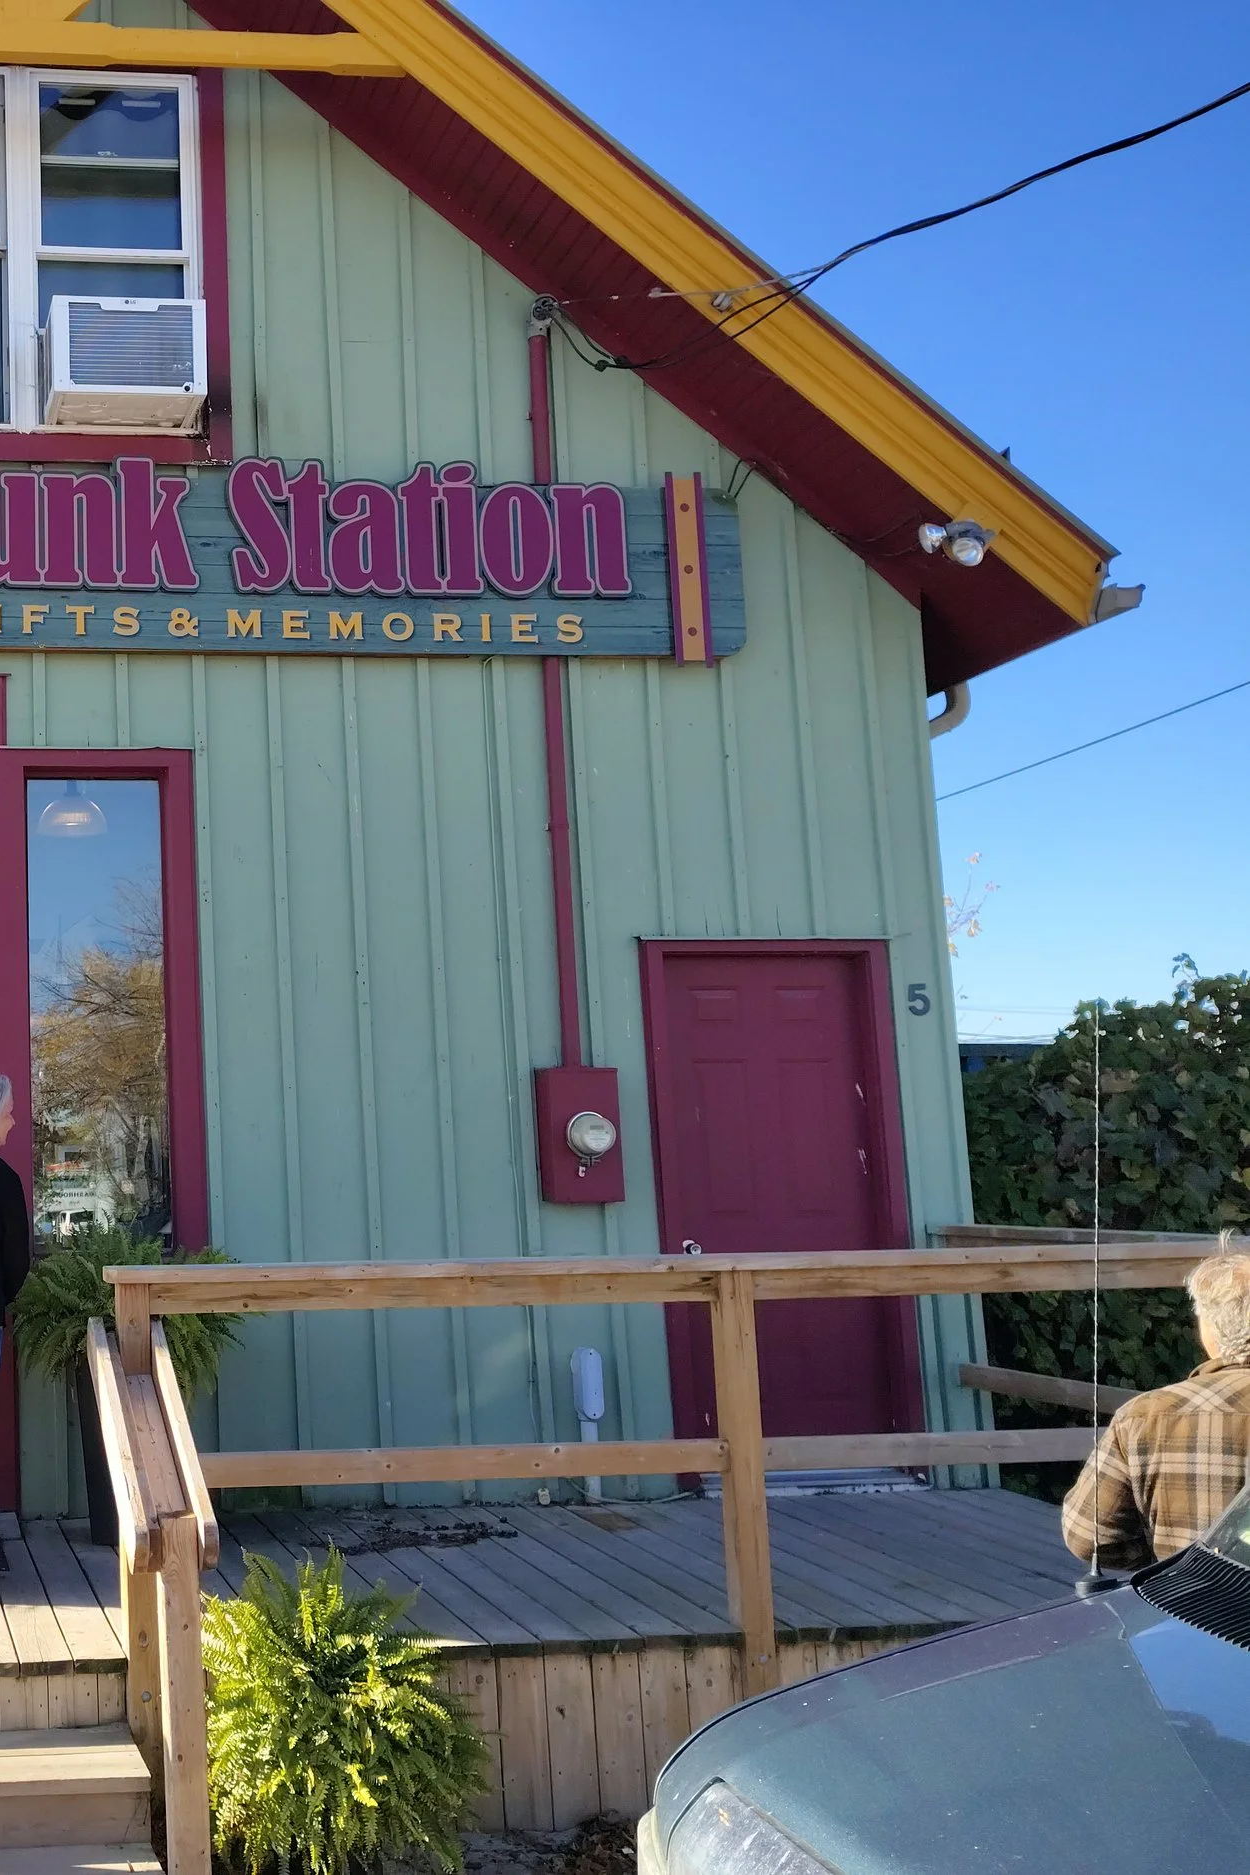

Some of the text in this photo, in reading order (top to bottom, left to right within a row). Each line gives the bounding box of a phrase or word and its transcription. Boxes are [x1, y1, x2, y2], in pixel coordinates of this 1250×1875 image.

[227, 456, 633, 598] Station
[167, 607, 199, 638] &
[226, 608, 584, 644] MEMORIES
[908, 983, 931, 1016] 5
